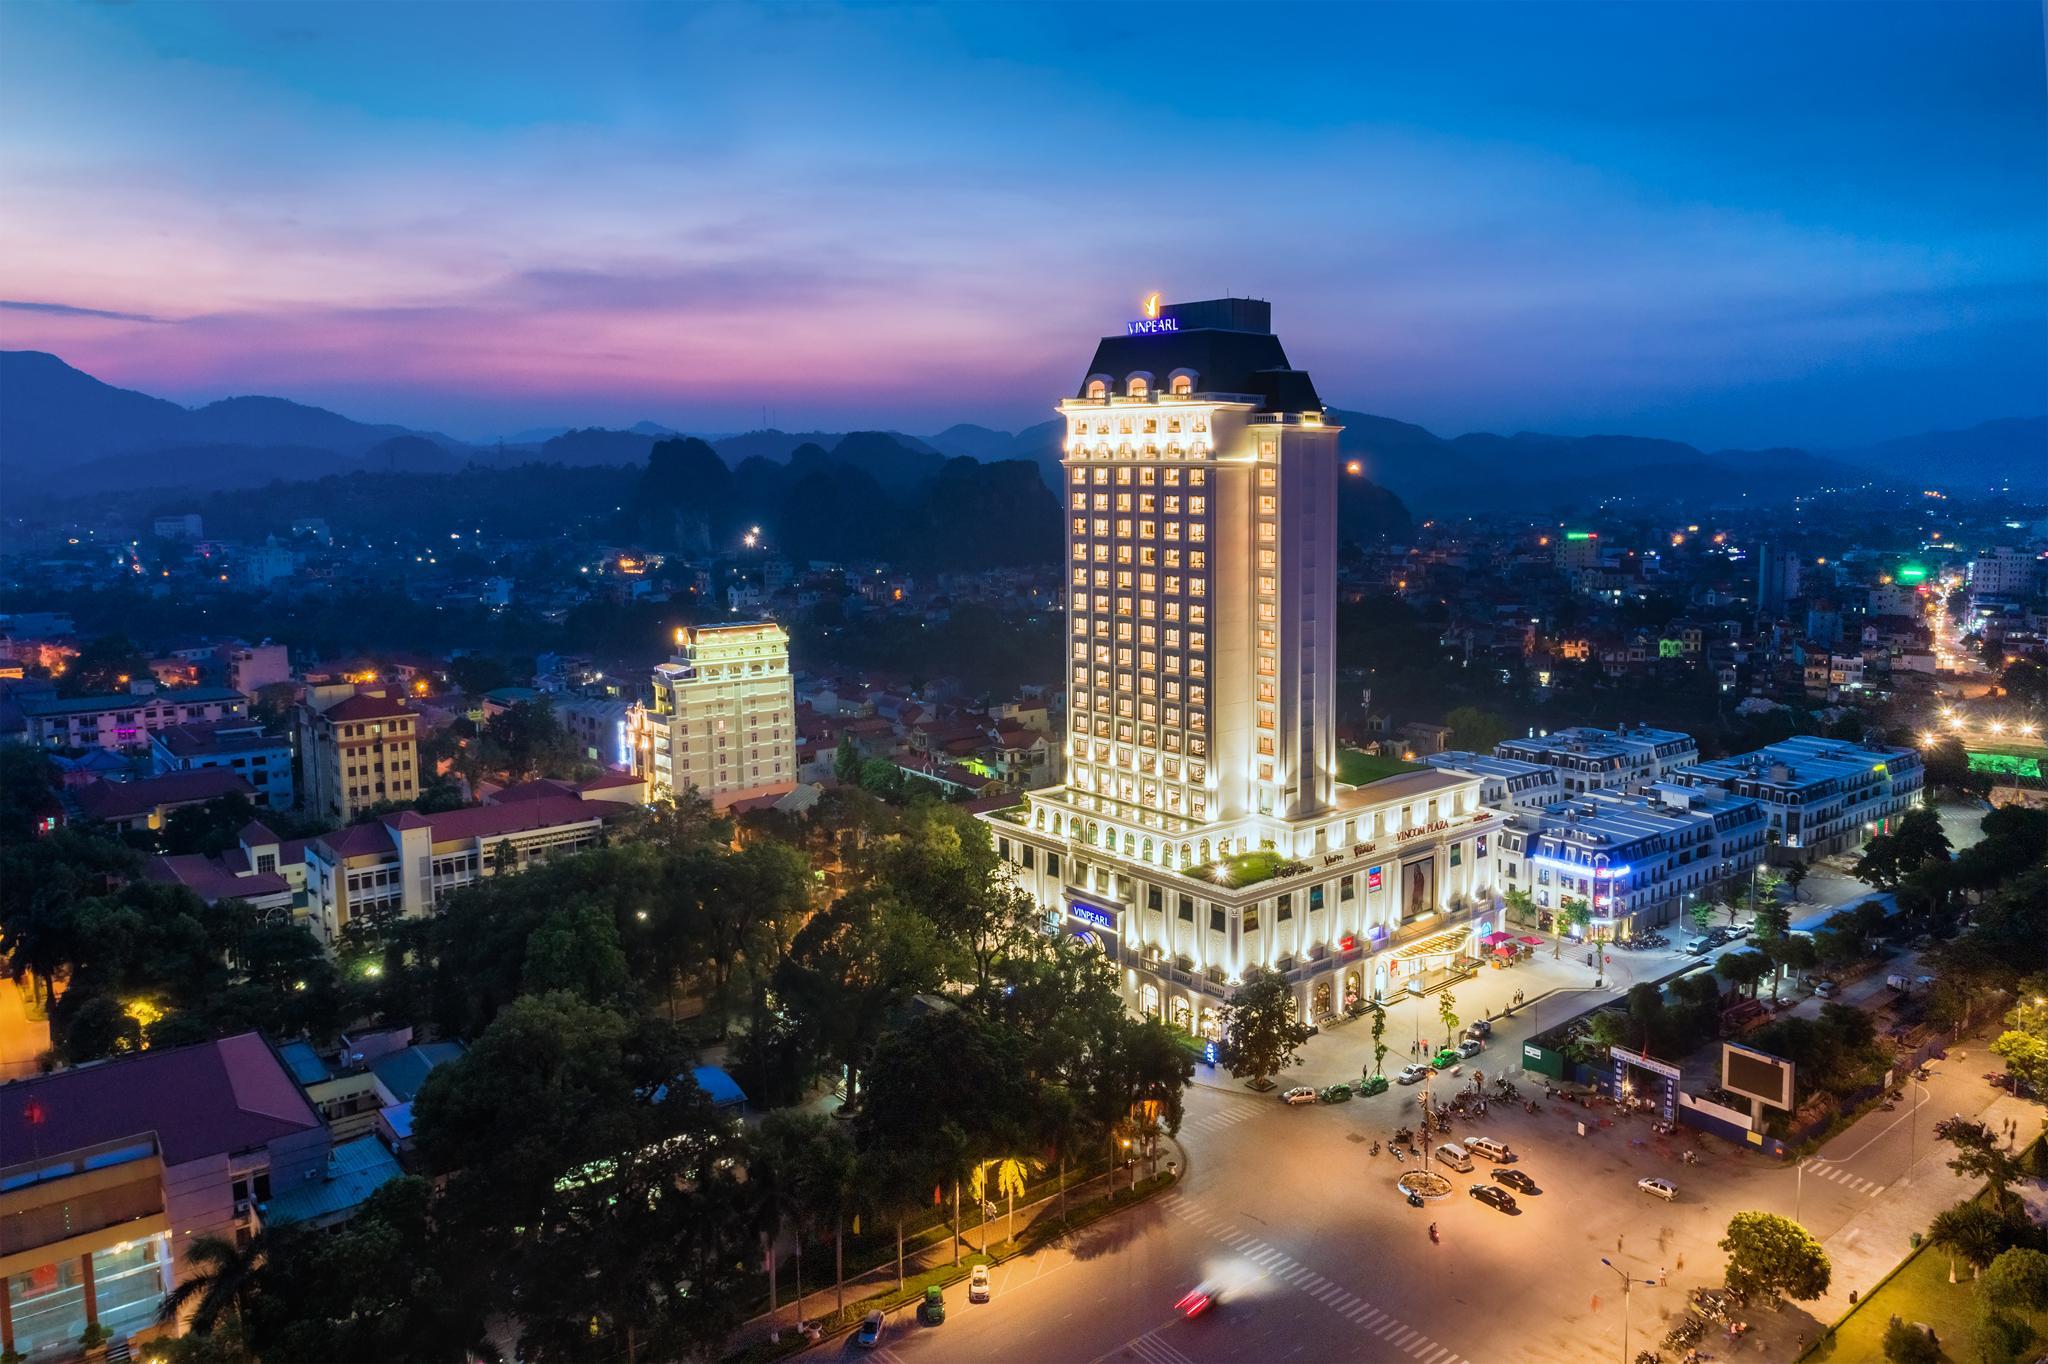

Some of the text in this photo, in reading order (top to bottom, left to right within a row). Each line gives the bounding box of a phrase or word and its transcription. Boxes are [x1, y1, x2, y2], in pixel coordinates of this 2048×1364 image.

[1128, 318, 1178, 335] VINPEARL
[1396, 819, 1449, 841] VINCOM PLAZA
[1073, 906, 1110, 927] VINPEARL
